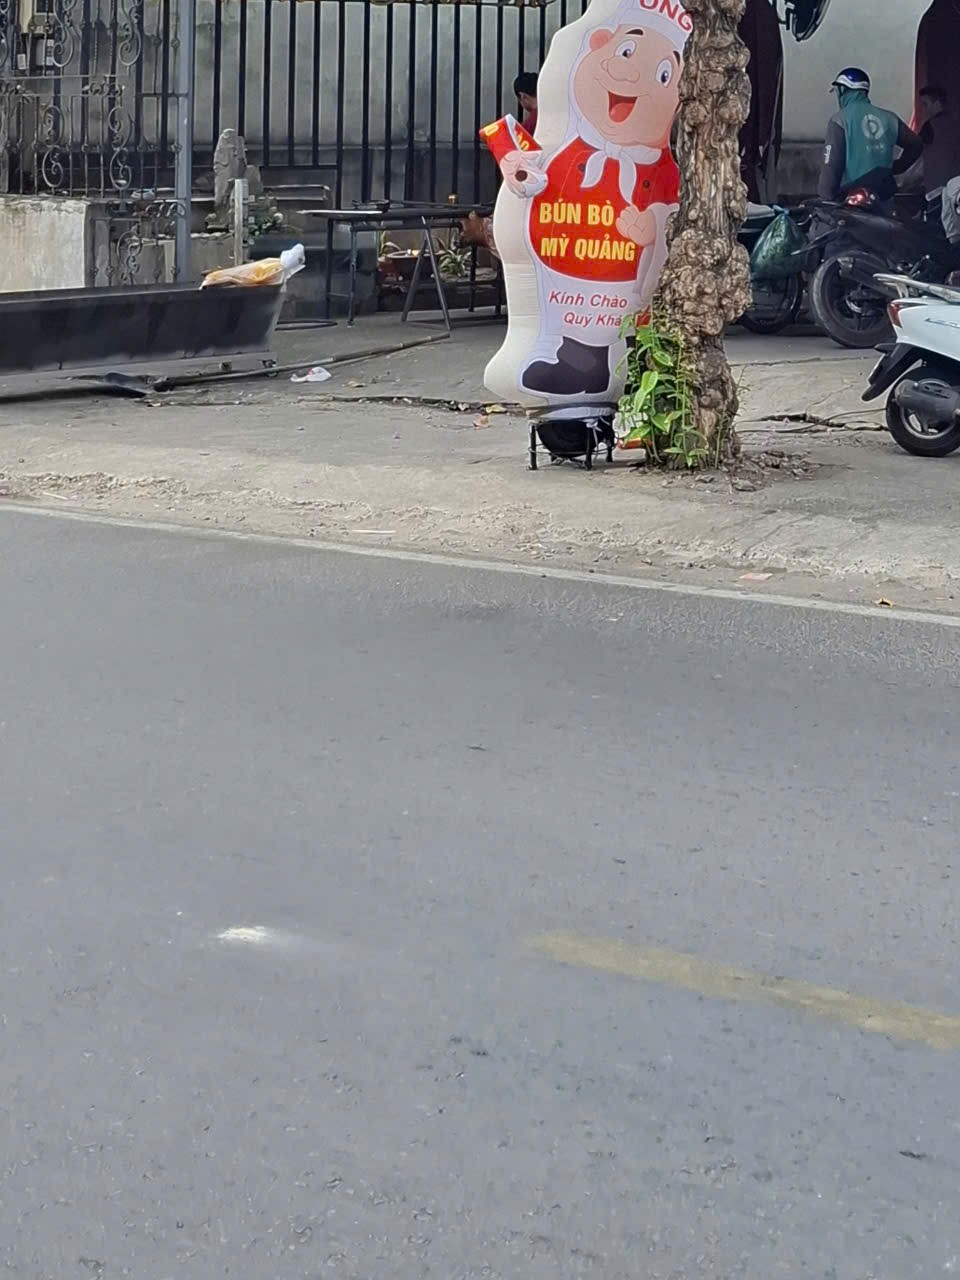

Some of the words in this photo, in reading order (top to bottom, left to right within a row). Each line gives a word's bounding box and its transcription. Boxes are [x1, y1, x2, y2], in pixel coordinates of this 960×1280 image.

[540, 198, 581, 225] BÚN
[587, 200, 615, 226] BÒ
[574, 234, 636, 262] QUẢNG
[549, 291, 585, 306] Kính
[589, 293, 629, 309] Chào
[563, 311, 593, 328] Quý
